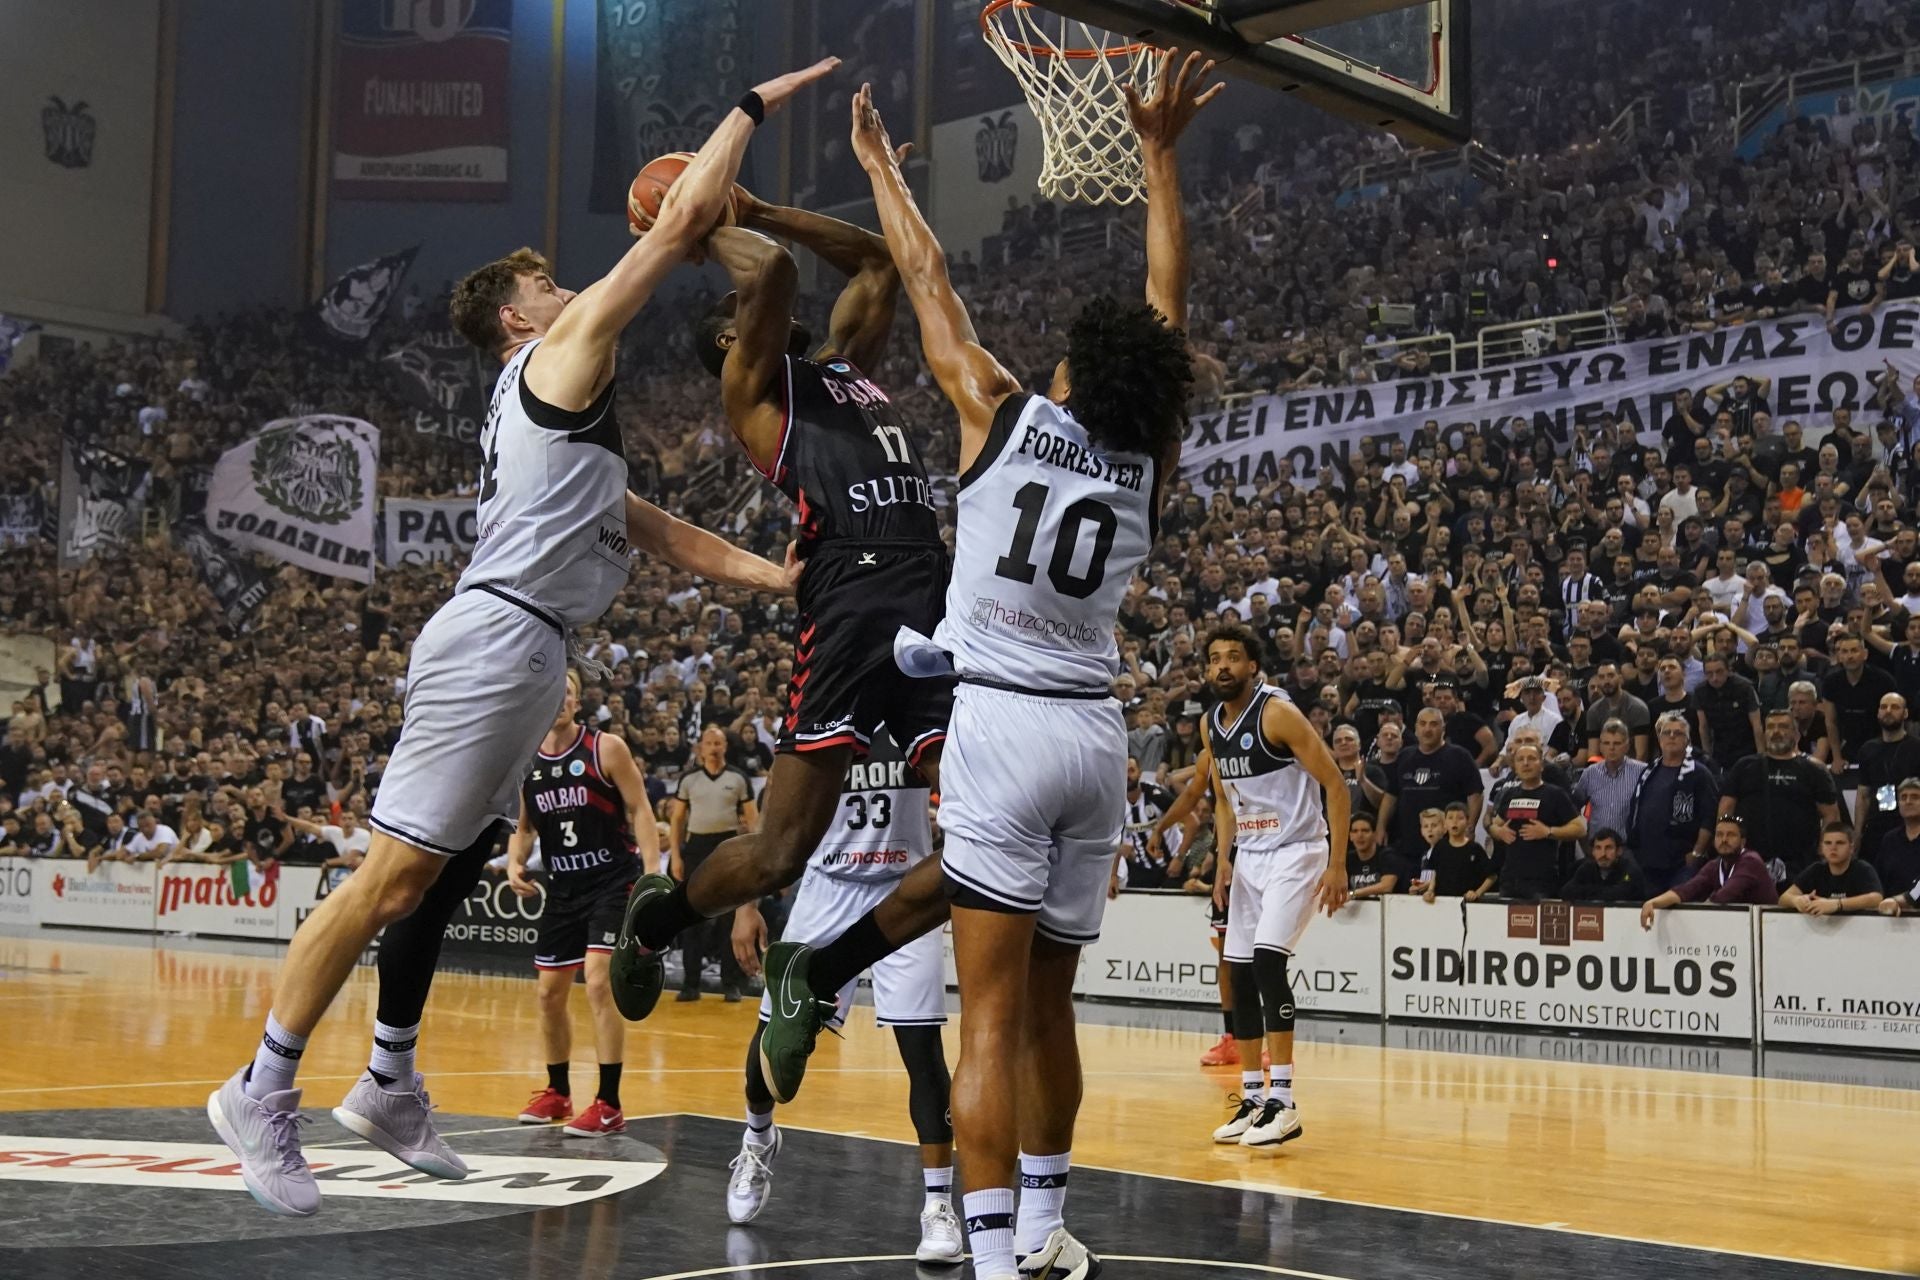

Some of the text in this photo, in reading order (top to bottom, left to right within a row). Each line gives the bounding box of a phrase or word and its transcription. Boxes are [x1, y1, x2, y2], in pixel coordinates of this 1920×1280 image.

[1284, 389, 1375, 431] ΕΝΑ
[1394, 352, 1627, 415] ΠΙΣΤΕΥΩ
[1648, 320, 1809, 376] ΕΝΑΣ
[872, 425, 911, 464] 17
[1018, 425, 1144, 491] FORRESTER
[995, 481, 1119, 600] 10
[993, 600, 1098, 642] hatzopoulos
[813, 723, 825, 731] EL
[845, 761, 906, 790] AOK
[535, 786, 588, 813] BILBAO
[846, 793, 891, 830] 33
[559, 820, 578, 848] 3
[822, 849, 907, 866] winmasters
[1666, 944, 1738, 958] since 1960
[1106, 958, 1358, 993] ΣΙΔΗΡΟΛΟΣ
[1391, 946, 1738, 998] SIDIROPOULOS
[1138, 986, 1219, 1000] ΗΛΕΚΤΡΟΛΟΓΙΚΟ
[1774, 995, 1806, 1011] ΑΠ.
[1817, 997, 1832, 1012] Γ.
[1405, 995, 1720, 1032] FURNITURE CONSTRUCTION
[1773, 1015, 1867, 1031] ΑΝΤΙΠΡΟΣΩΠΕΙΕΣ
[1021, 1175, 1055, 1187] GSA
[966, 1217, 987, 1233] SA
